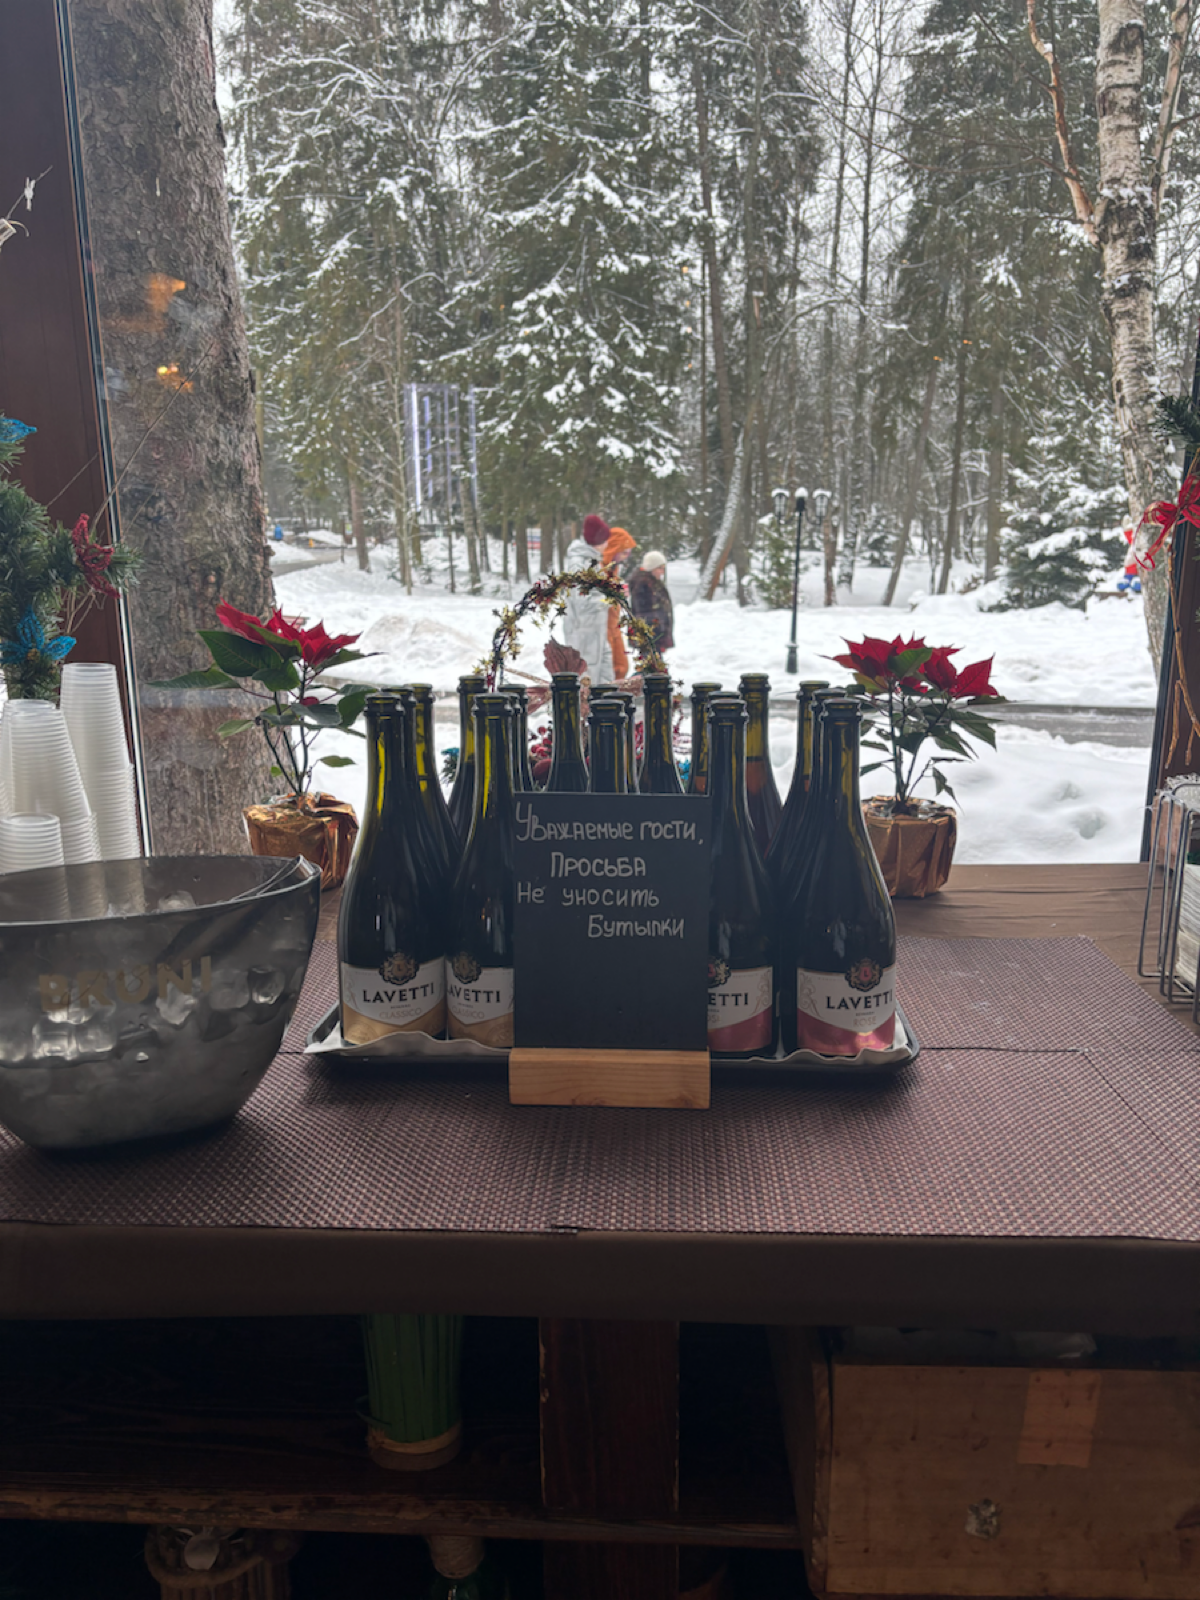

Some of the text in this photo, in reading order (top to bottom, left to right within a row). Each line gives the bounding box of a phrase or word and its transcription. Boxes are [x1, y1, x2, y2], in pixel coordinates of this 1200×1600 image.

[639, 820, 704, 845] гости,
[550, 851, 647, 878] Просьба
[516, 881, 660, 907] Не уносить
[38, 956, 212, 1012] BRUNI
[362, 982, 434, 1004] LAVETTI
[447, 988, 501, 1003] AVETTI
[708, 992, 749, 1006] ETTI
[826, 989, 893, 1010] LAVETTI
